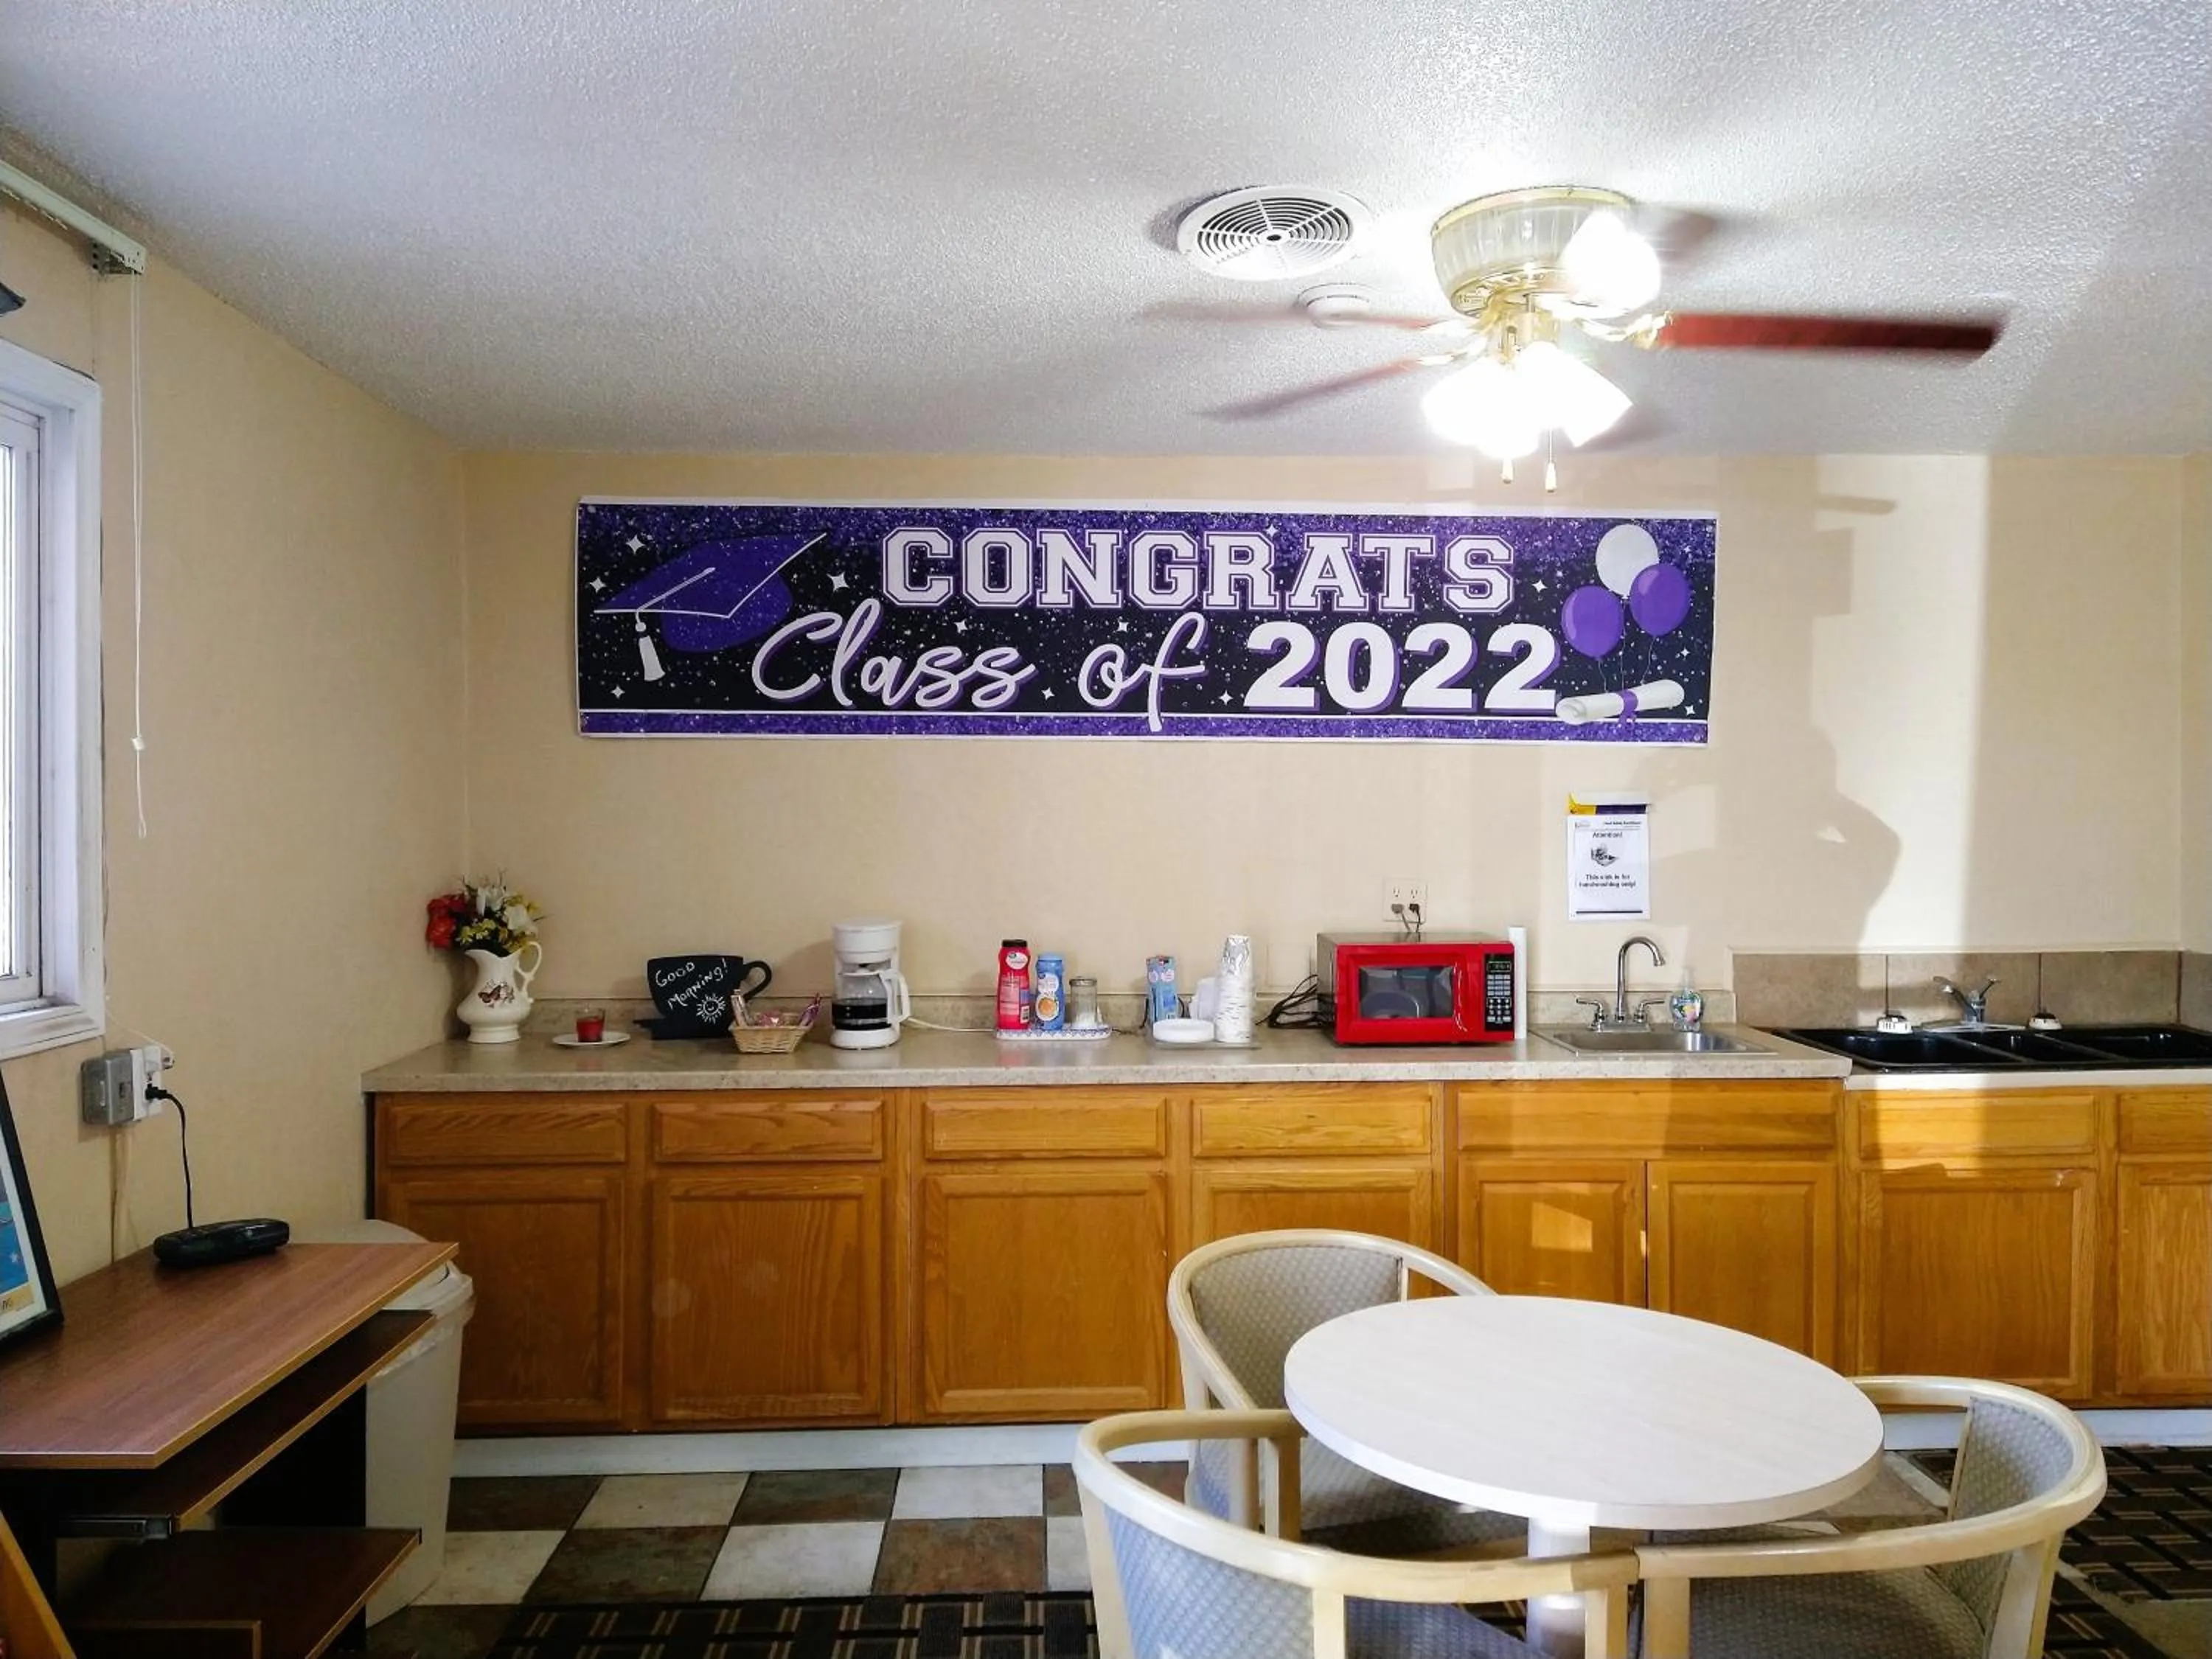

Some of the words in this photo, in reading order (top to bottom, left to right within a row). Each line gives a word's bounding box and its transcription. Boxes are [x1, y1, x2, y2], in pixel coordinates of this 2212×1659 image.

[883, 527, 1515, 613] CONGRATS
[751, 597, 1036, 710] Class
[1077, 611, 1208, 732] of
[1243, 621, 1562, 713] 2022
